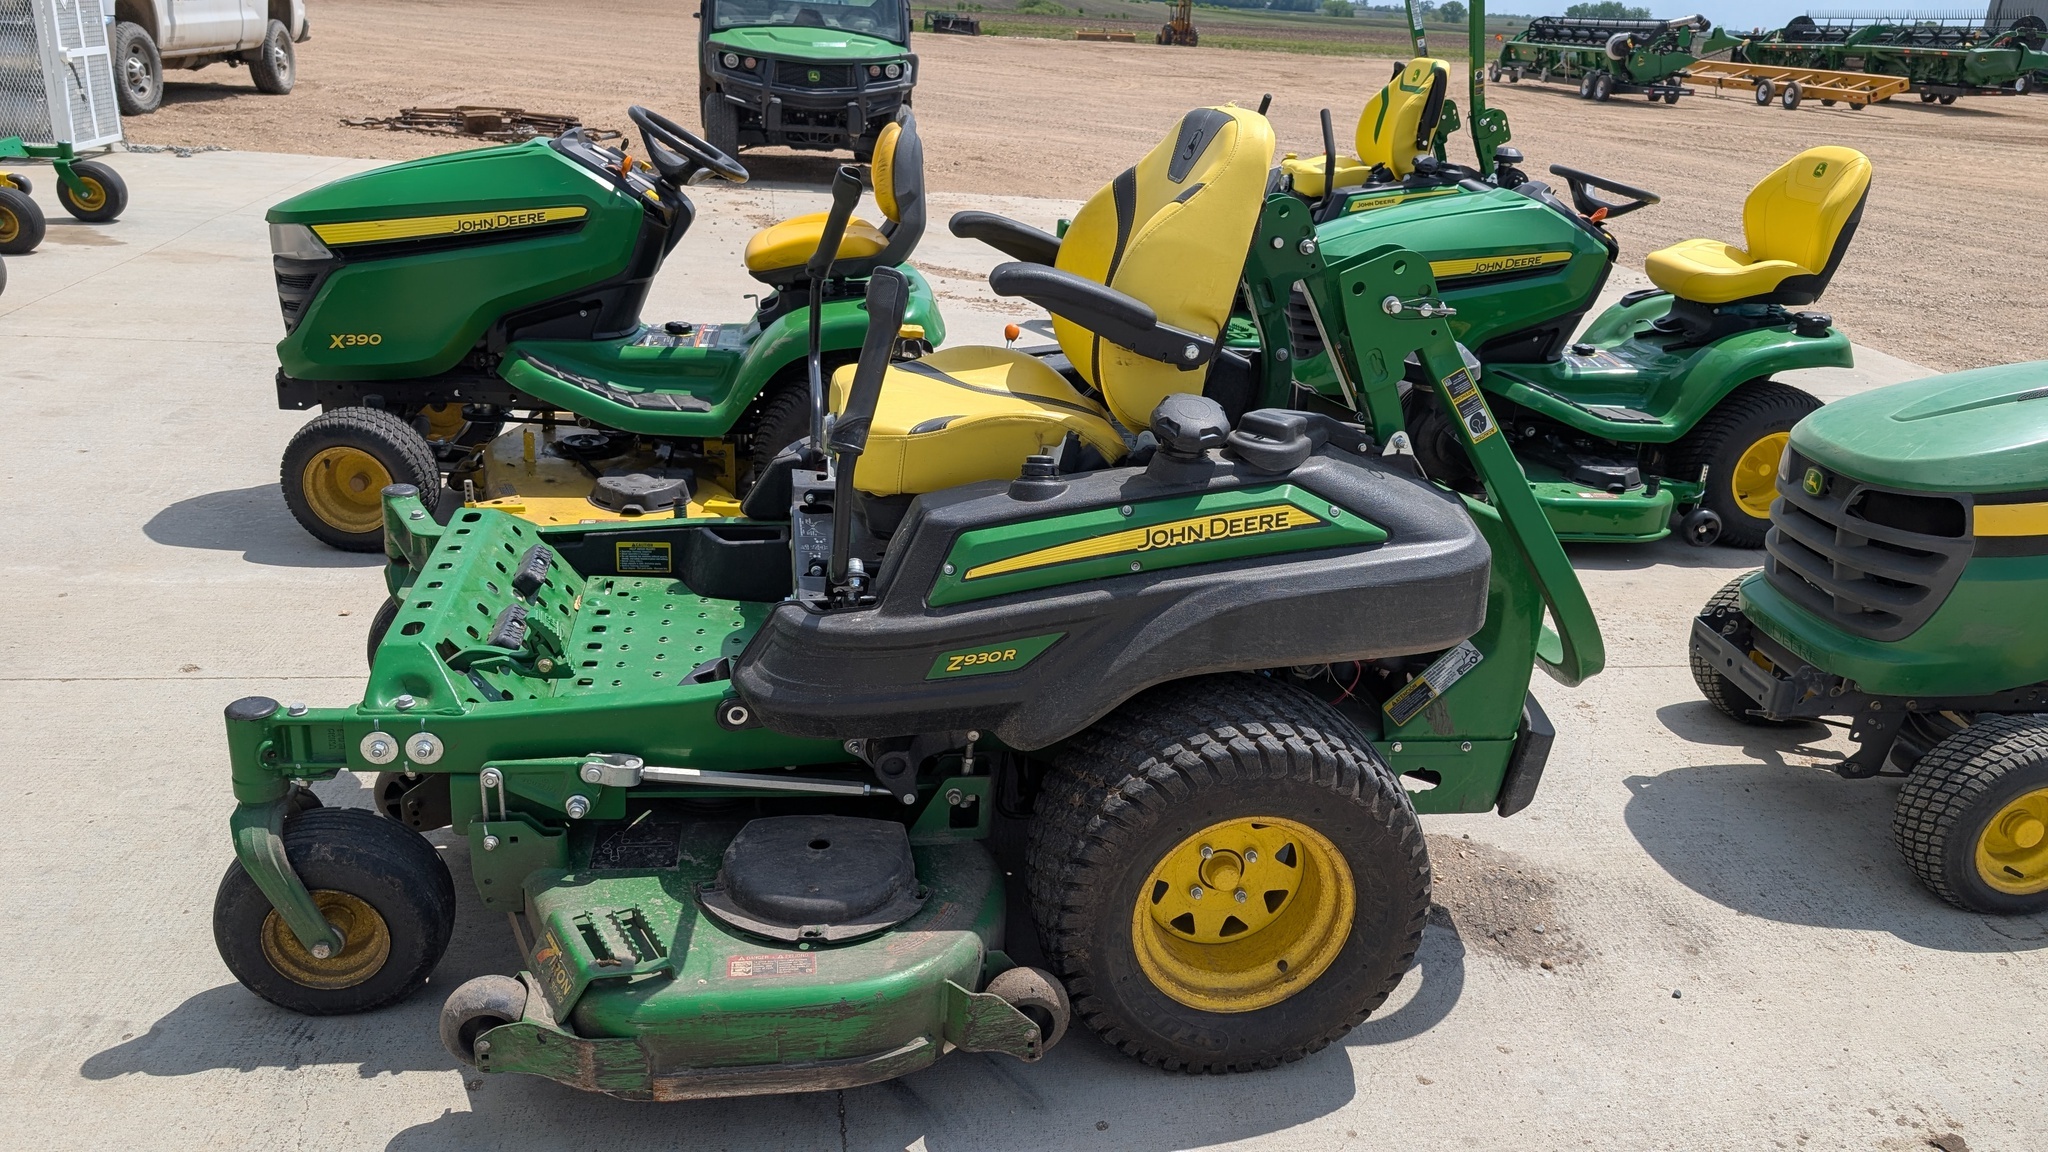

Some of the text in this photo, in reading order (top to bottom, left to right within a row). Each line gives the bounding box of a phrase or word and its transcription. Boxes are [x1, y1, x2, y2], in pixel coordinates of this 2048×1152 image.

[453, 212, 546, 233] JOHN DEERE
[1471, 256, 1542, 273] JOHN DEERE
[329, 333, 382, 349] X390
[1137, 511, 1290, 550] JOHN DEERE
[946, 649, 1017, 672] Z930R
